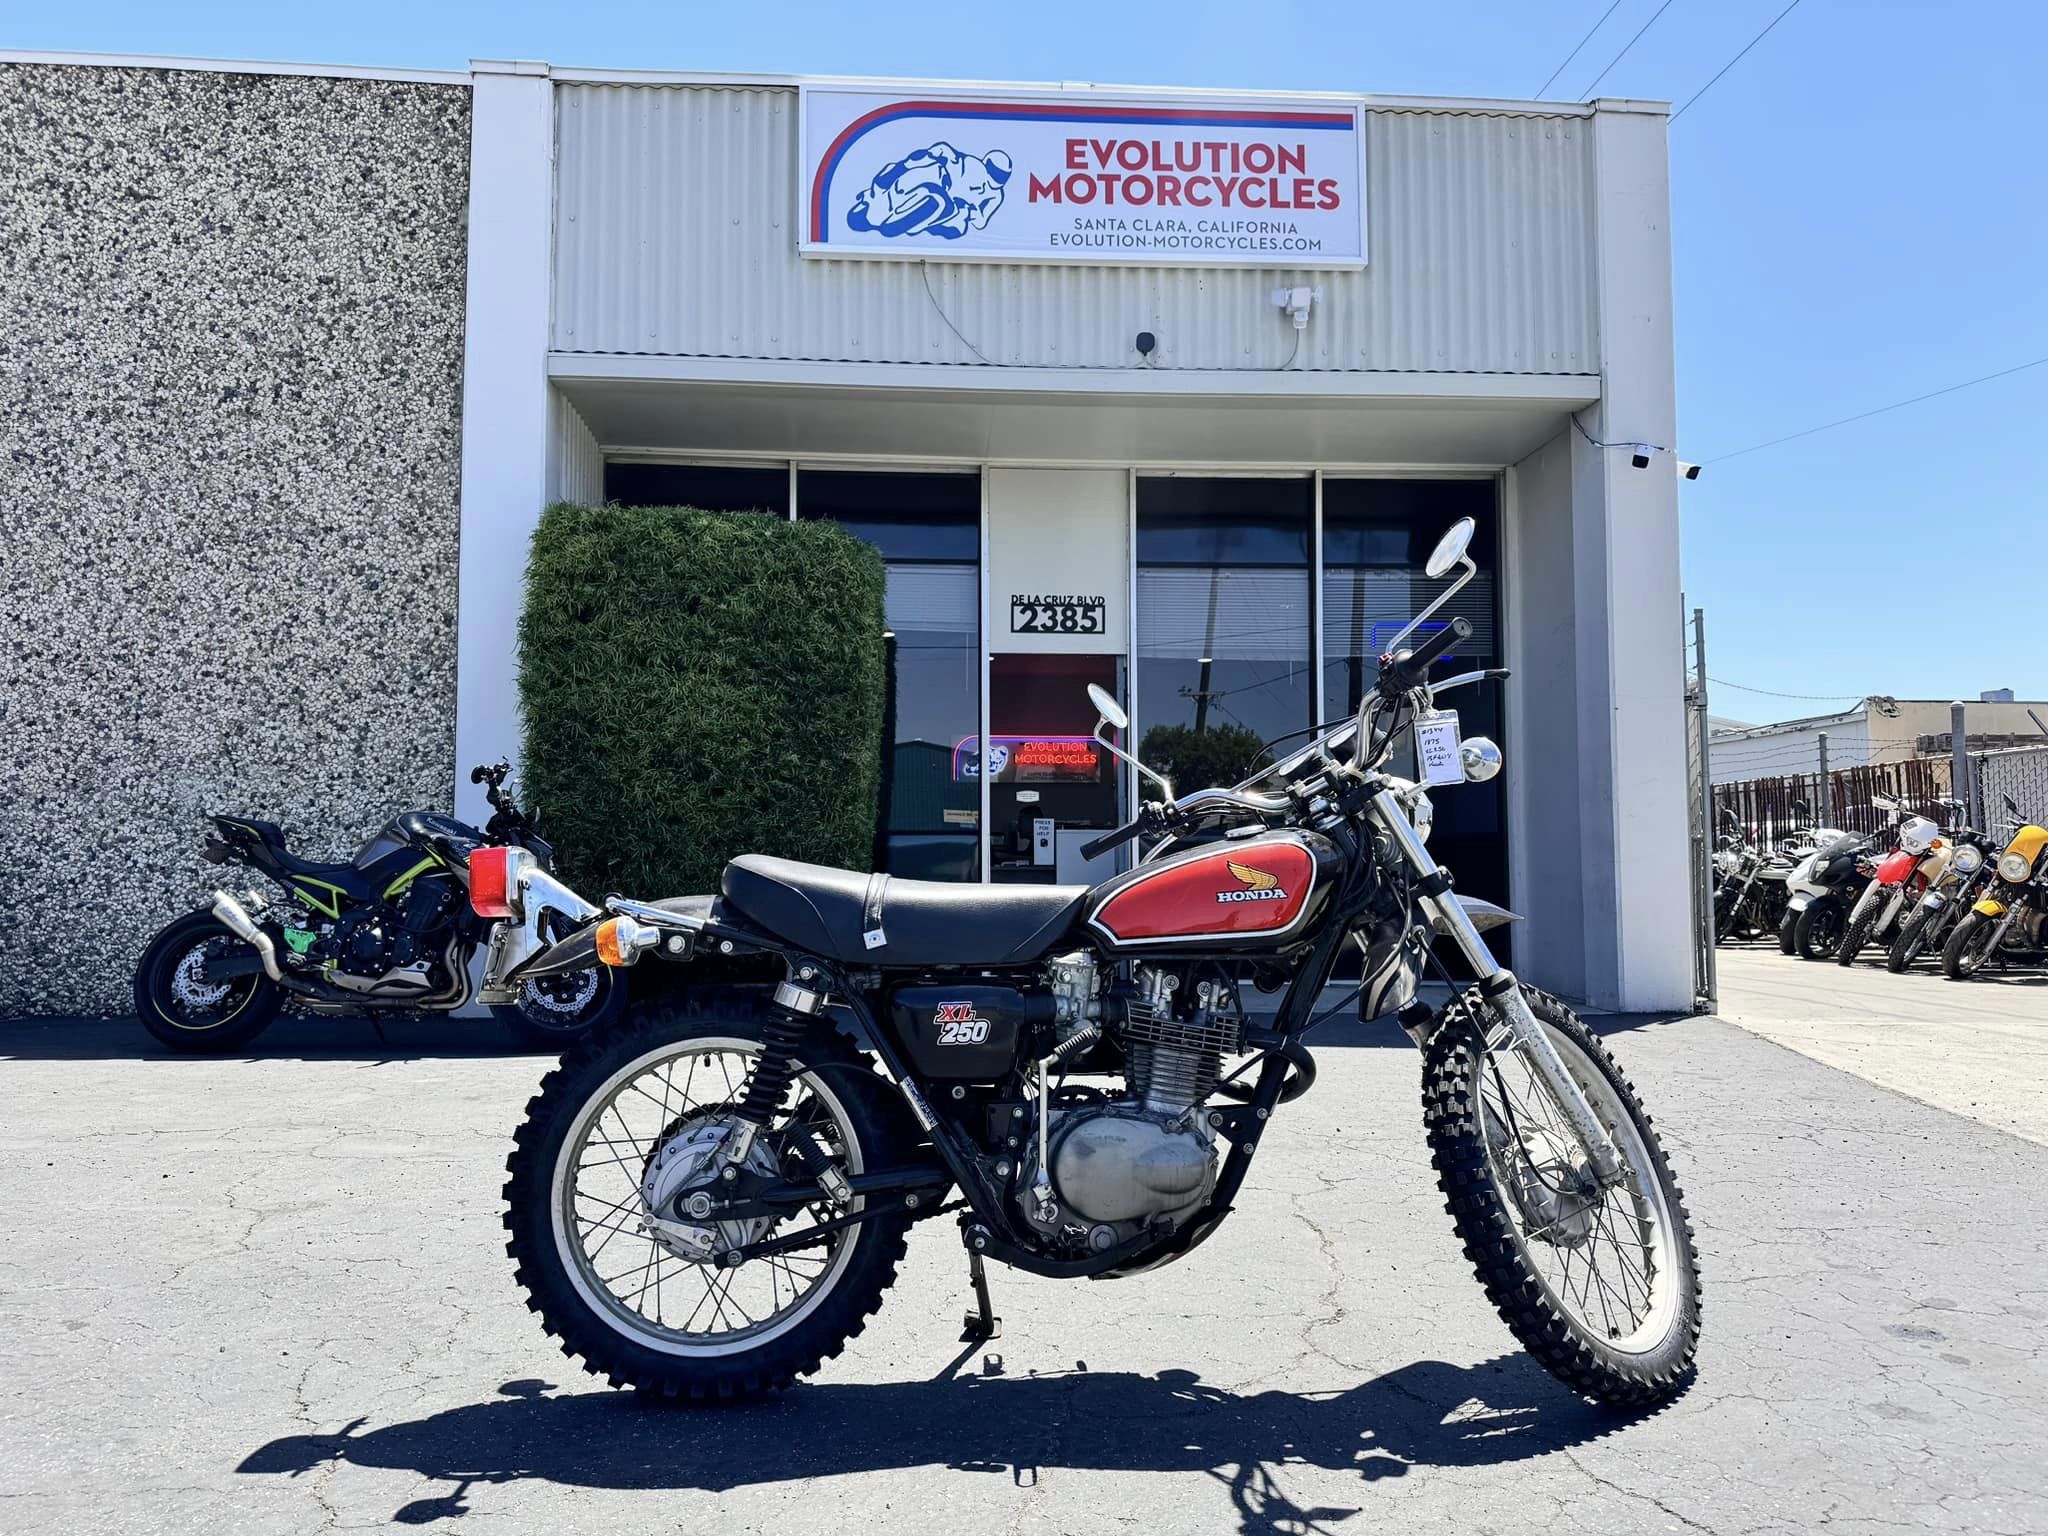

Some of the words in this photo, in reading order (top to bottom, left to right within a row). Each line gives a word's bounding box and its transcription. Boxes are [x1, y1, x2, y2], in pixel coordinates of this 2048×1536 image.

[1064, 138, 1307, 175] EVOLUTION
[1028, 171, 1341, 211] MOTORCYCLES
[1073, 217, 1128, 232] SANTA
[1132, 219, 1193, 234] CLARA,
[1197, 220, 1299, 235] CALIFORNIA
[1049, 232, 1322, 252] EVOLUTION-MOTORCYCLES.COM
[1011, 594, 1025, 604] DE
[1027, 594, 1041, 605] LA
[1044, 594, 1074, 605] CRUZ
[1077, 595, 1105, 606] BLVD
[1019, 603, 1098, 633] 2385
[1023, 741, 1088, 752] EVOLUTION
[1014, 753, 1097, 764] MOTORCYCLES
[1216, 888, 1288, 903] HONDA
[936, 1003, 976, 1022] XL
[940, 1021, 989, 1043] 250
